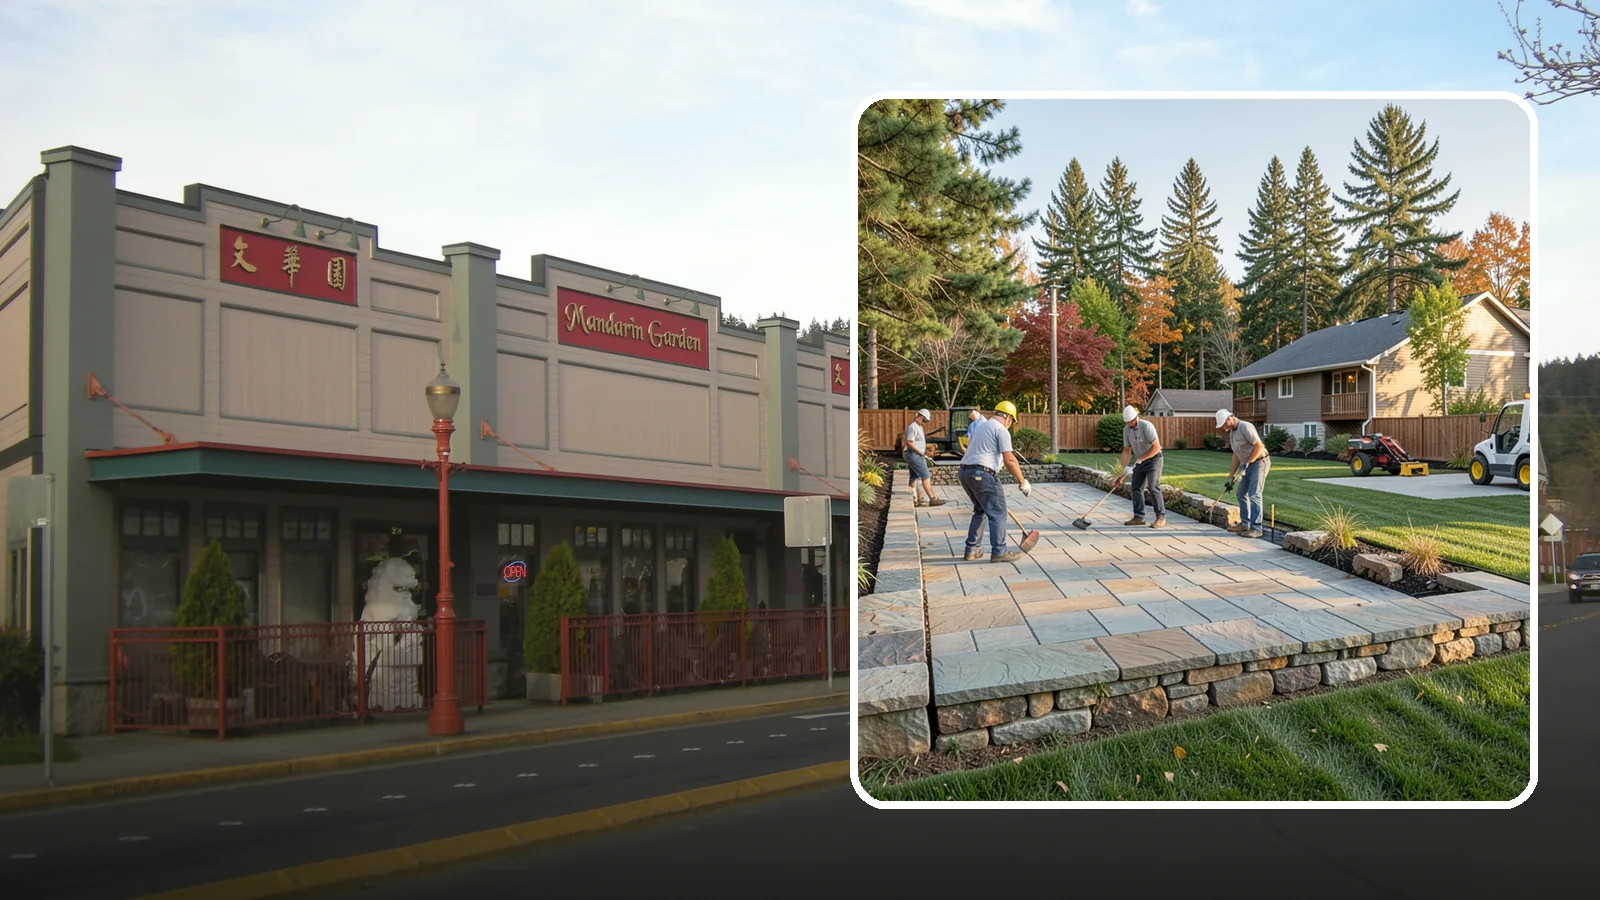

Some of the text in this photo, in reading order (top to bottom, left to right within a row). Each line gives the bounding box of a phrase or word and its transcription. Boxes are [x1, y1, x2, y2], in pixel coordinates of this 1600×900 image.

[230, 235, 346, 291] 文華園
[564, 302, 702, 352] Mandarin Garden
[503, 565, 527, 578] OPEN
